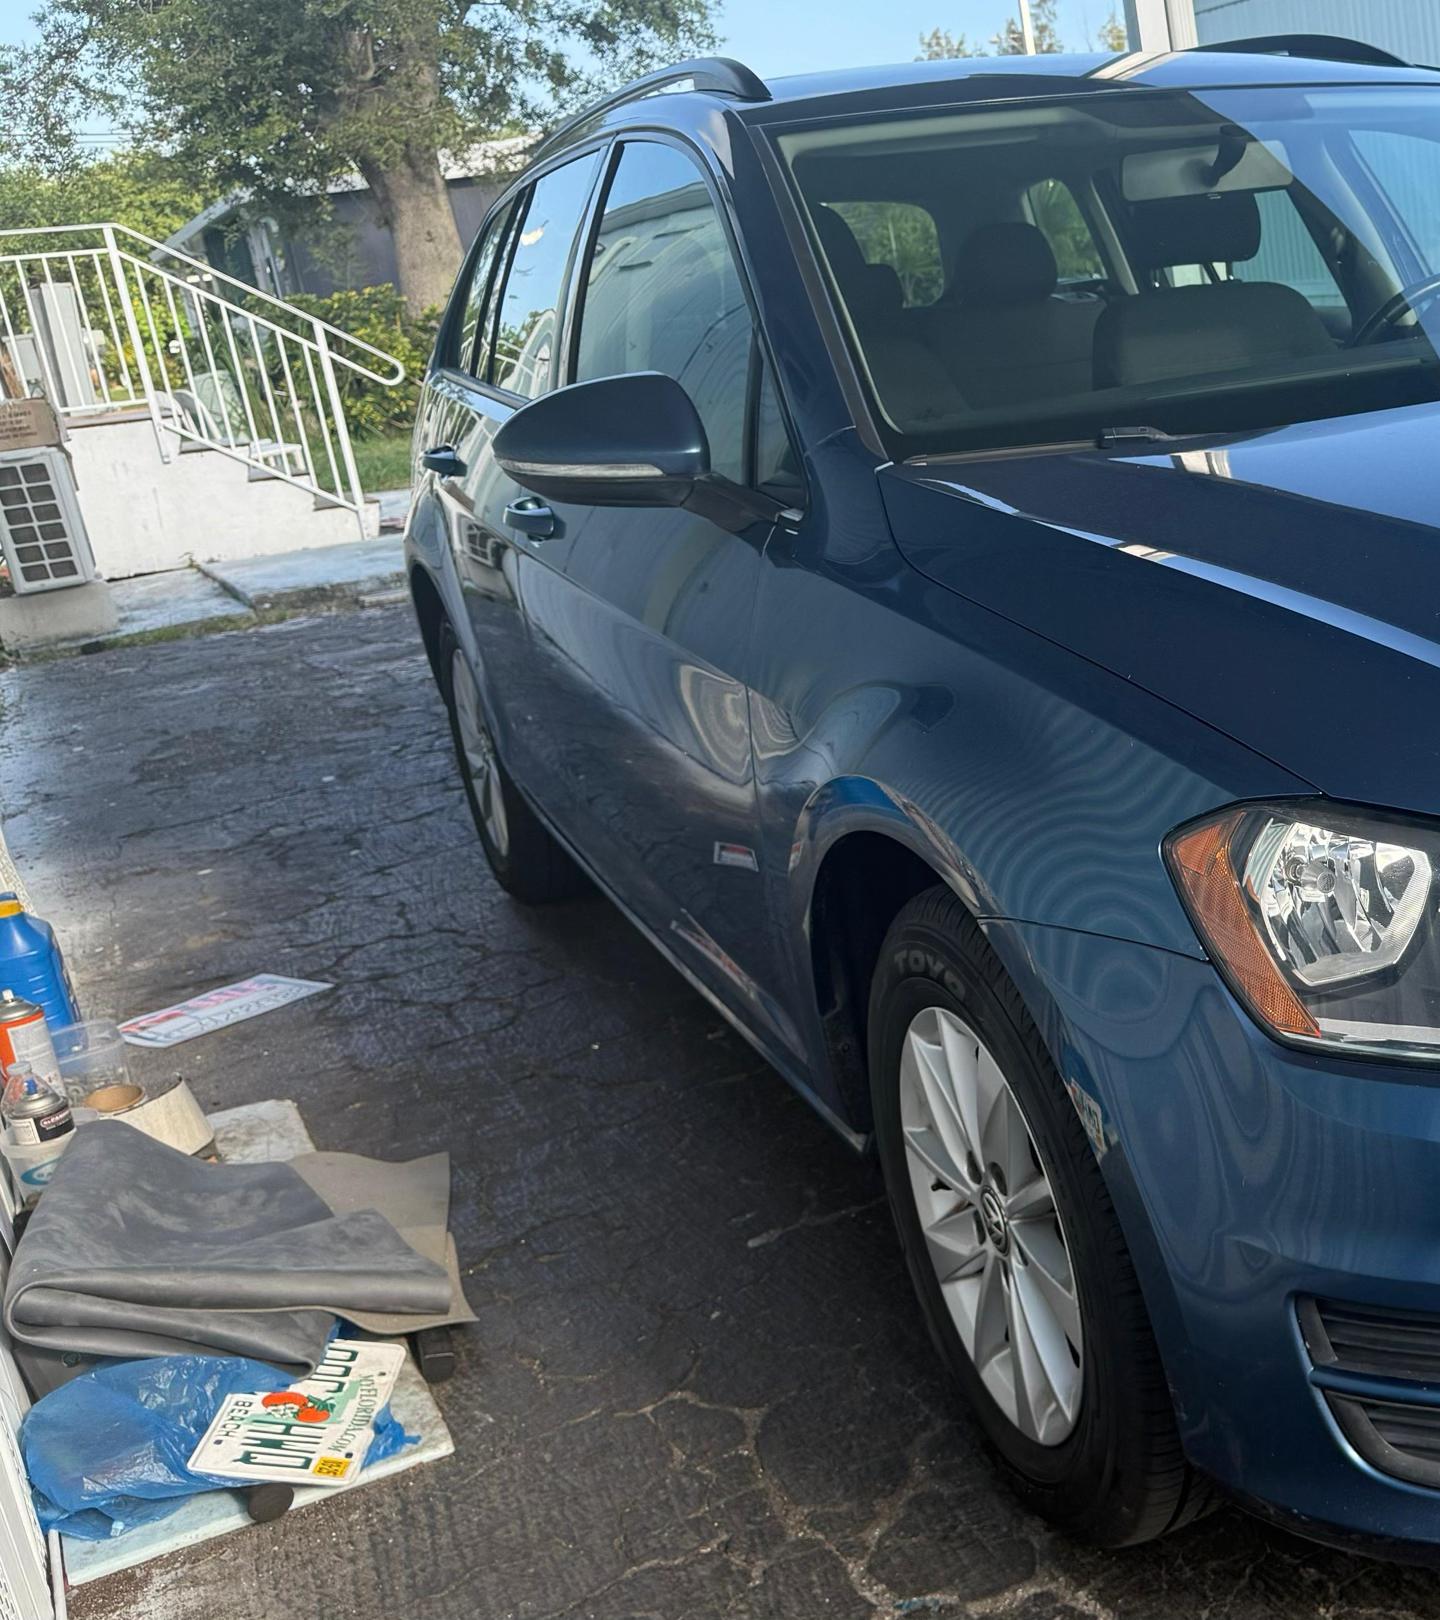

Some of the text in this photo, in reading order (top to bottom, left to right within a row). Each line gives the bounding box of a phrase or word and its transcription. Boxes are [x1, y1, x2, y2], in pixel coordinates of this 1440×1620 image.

[894, 948, 966, 1002] TOYO
[220, 1400, 253, 1438] BEACH
[233, 1419, 327, 1470] HWQ
